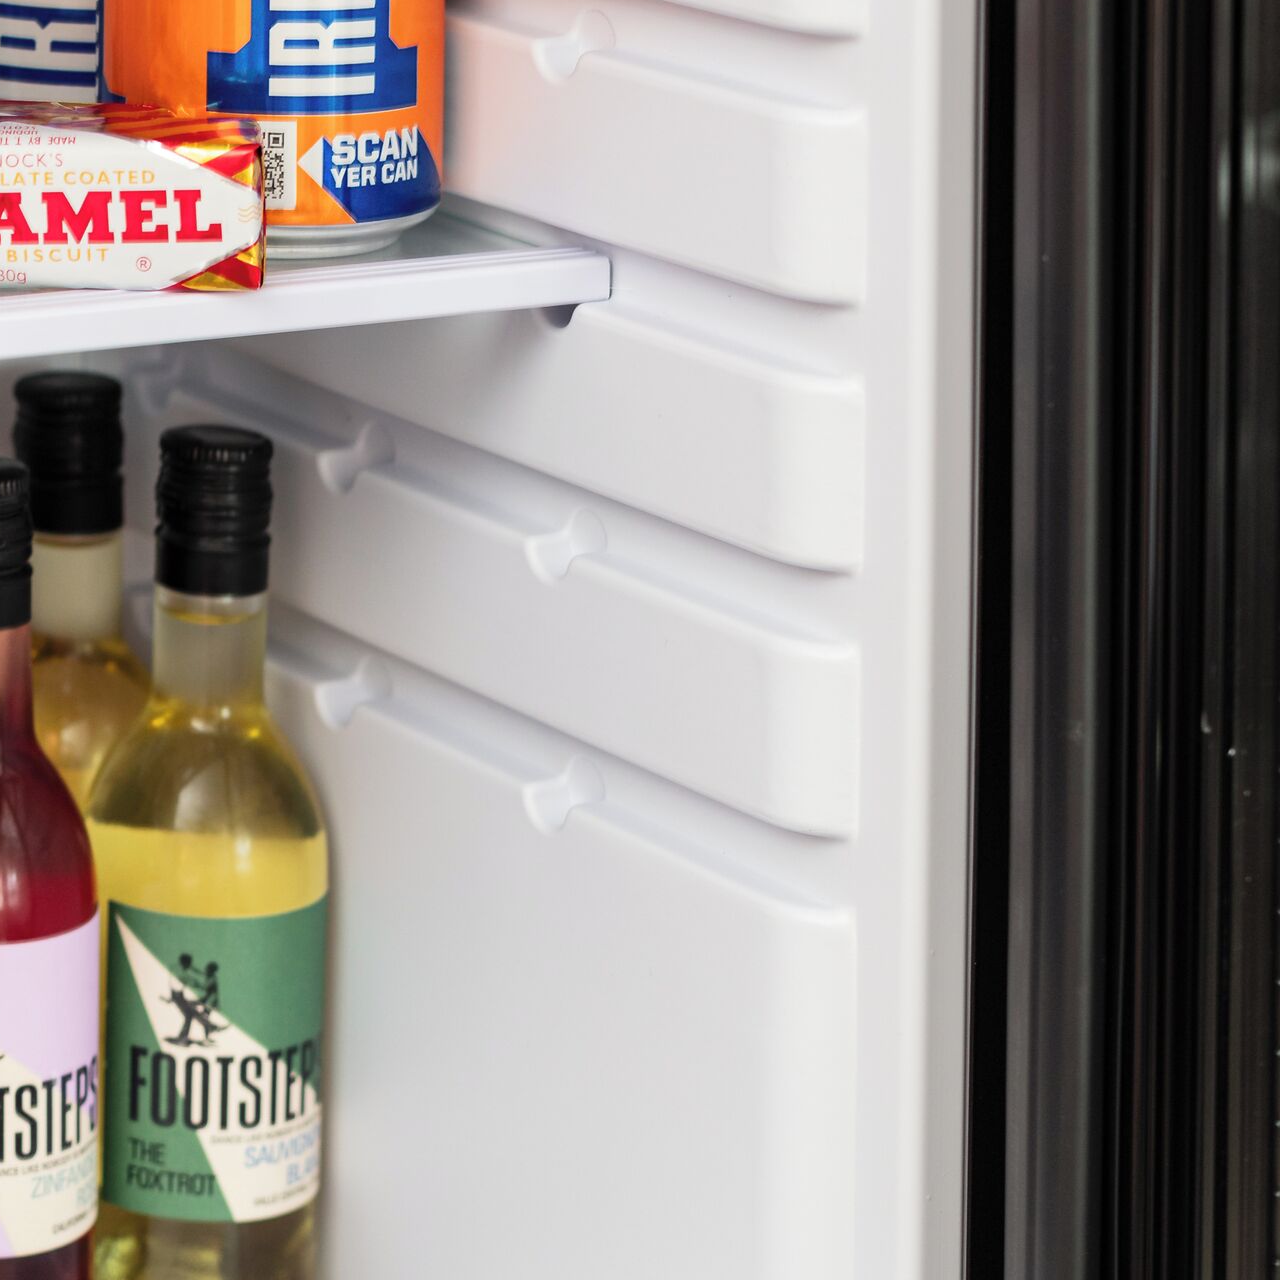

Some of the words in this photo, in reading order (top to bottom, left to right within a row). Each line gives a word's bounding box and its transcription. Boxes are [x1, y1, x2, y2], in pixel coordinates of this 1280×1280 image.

[28, 136, 40, 146] BY
[47, 135, 76, 146] MADE
[331, 124, 419, 166] SCAN
[63, 169, 155, 186] COATED
[331, 163, 377, 189] YER
[381, 158, 418, 185] CAN
[7, 247, 109, 264] BISCUIT
[130, 1039, 319, 1131] FOOTSTEP
[128, 1136, 165, 1165] THE
[125, 1163, 217, 1196] FOXTROT
